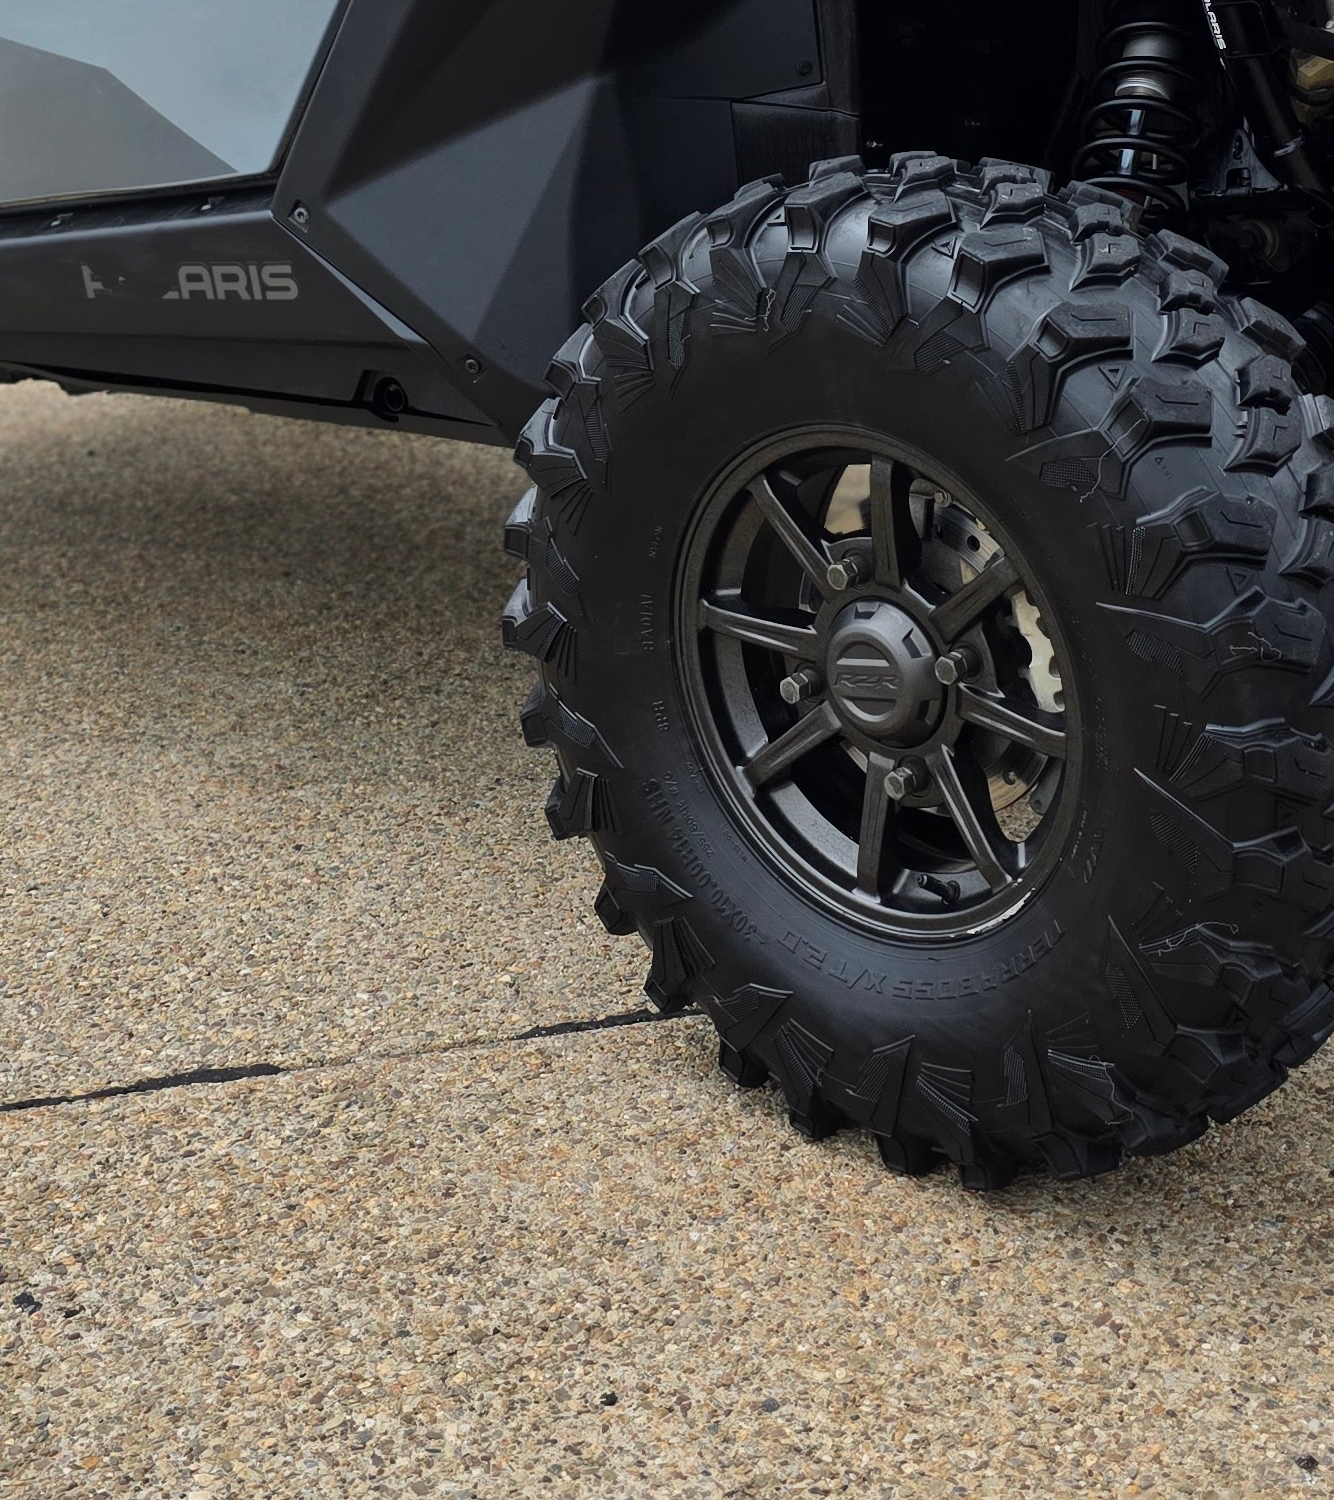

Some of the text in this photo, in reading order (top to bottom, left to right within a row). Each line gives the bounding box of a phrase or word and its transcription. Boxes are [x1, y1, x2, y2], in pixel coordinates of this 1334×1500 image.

[80, 264, 299, 300] ARIS
[833, 673, 900, 690] RZR
[892, 920, 1069, 1000] TERRABOSS
